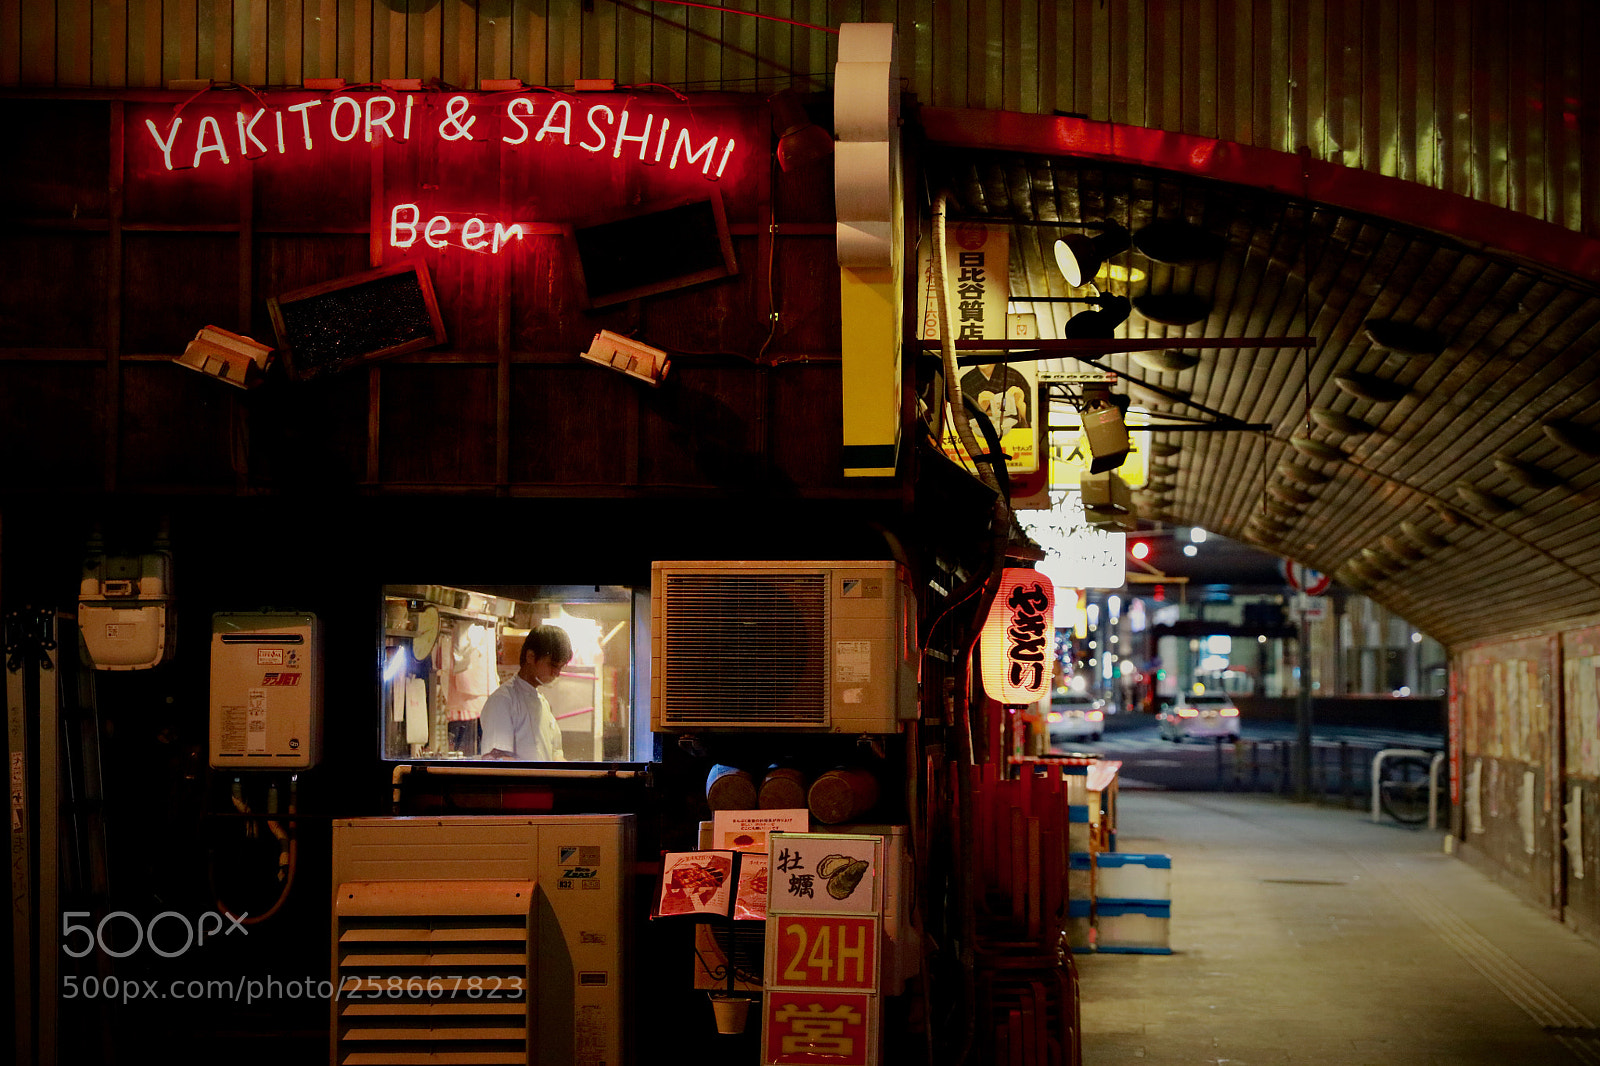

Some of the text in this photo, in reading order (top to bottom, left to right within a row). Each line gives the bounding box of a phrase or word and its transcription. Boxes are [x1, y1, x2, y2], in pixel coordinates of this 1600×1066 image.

[145, 95, 736, 177] YAKITORI & SASHIMI
[389, 203, 524, 254] Beer
[957, 252, 986, 340] 日比谷質店
[1008, 583, 1050, 690] やきとり
[776, 848, 815, 899] 牡蠣
[783, 923, 866, 982] 24H
[775, 1003, 861, 1056] 営
